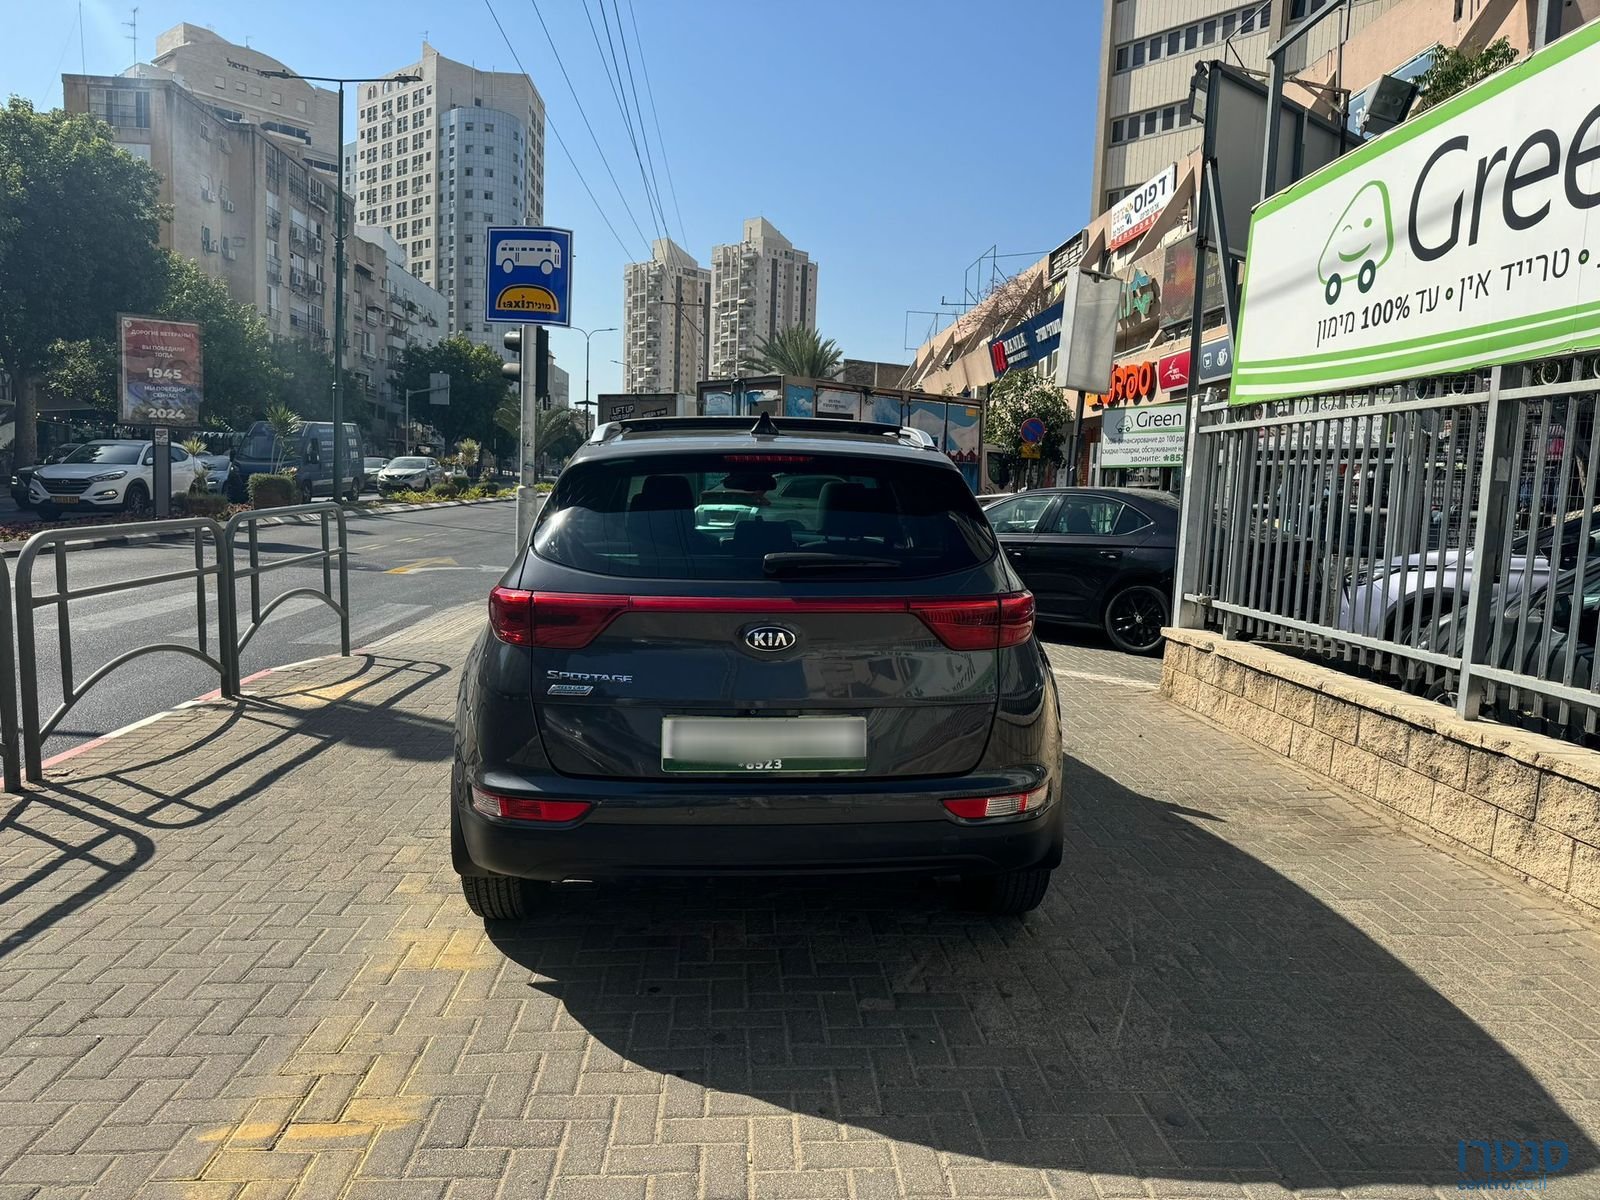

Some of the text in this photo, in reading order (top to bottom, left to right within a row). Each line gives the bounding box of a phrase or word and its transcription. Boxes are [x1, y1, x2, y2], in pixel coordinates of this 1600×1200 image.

[1134, 175, 1167, 214] דפוס
[502, 294, 525, 309] taxi
[1316, 247, 1570, 348] טרייד אין עד 100% מימון
[526, 300, 551, 310] מונית
[146, 367, 182, 380] 1945
[148, 408, 186, 420] 2024
[612, 407, 625, 415] LIFT
[625, 405, 634, 413] UP
[1136, 411, 1182, 428] Green
[1166, 435, 1175, 443] 100
[1130, 455, 1161, 463] звоните:
[754, 632, 787, 647] KIA
[546, 670, 633, 684] SPORTAGE
